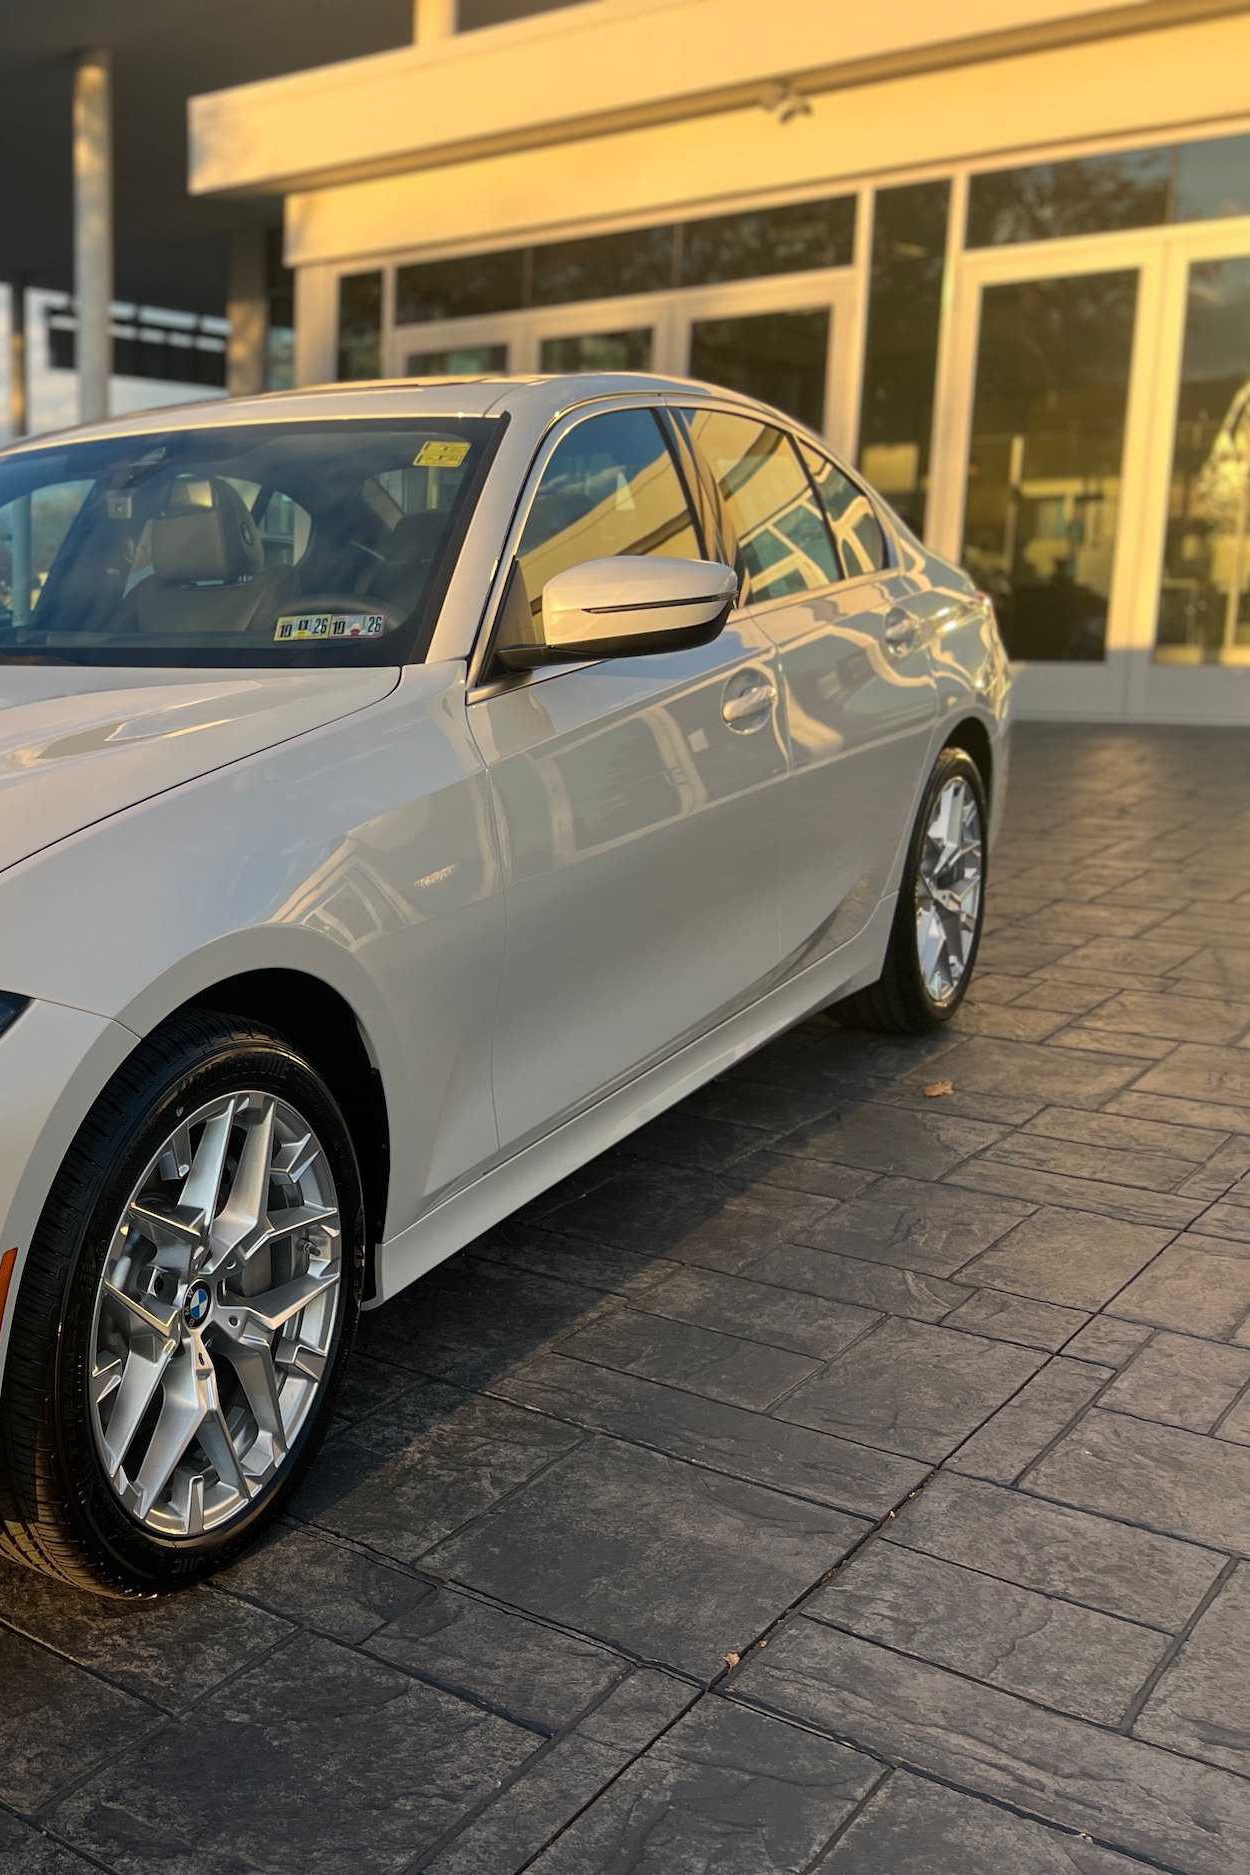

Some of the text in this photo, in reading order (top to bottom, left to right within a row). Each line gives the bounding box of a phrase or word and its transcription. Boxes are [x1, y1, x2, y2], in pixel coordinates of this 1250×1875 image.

[279, 618, 329, 638] 10 26
[332, 616, 382, 635] 10 26
[184, 1288, 196, 1327] BMW
